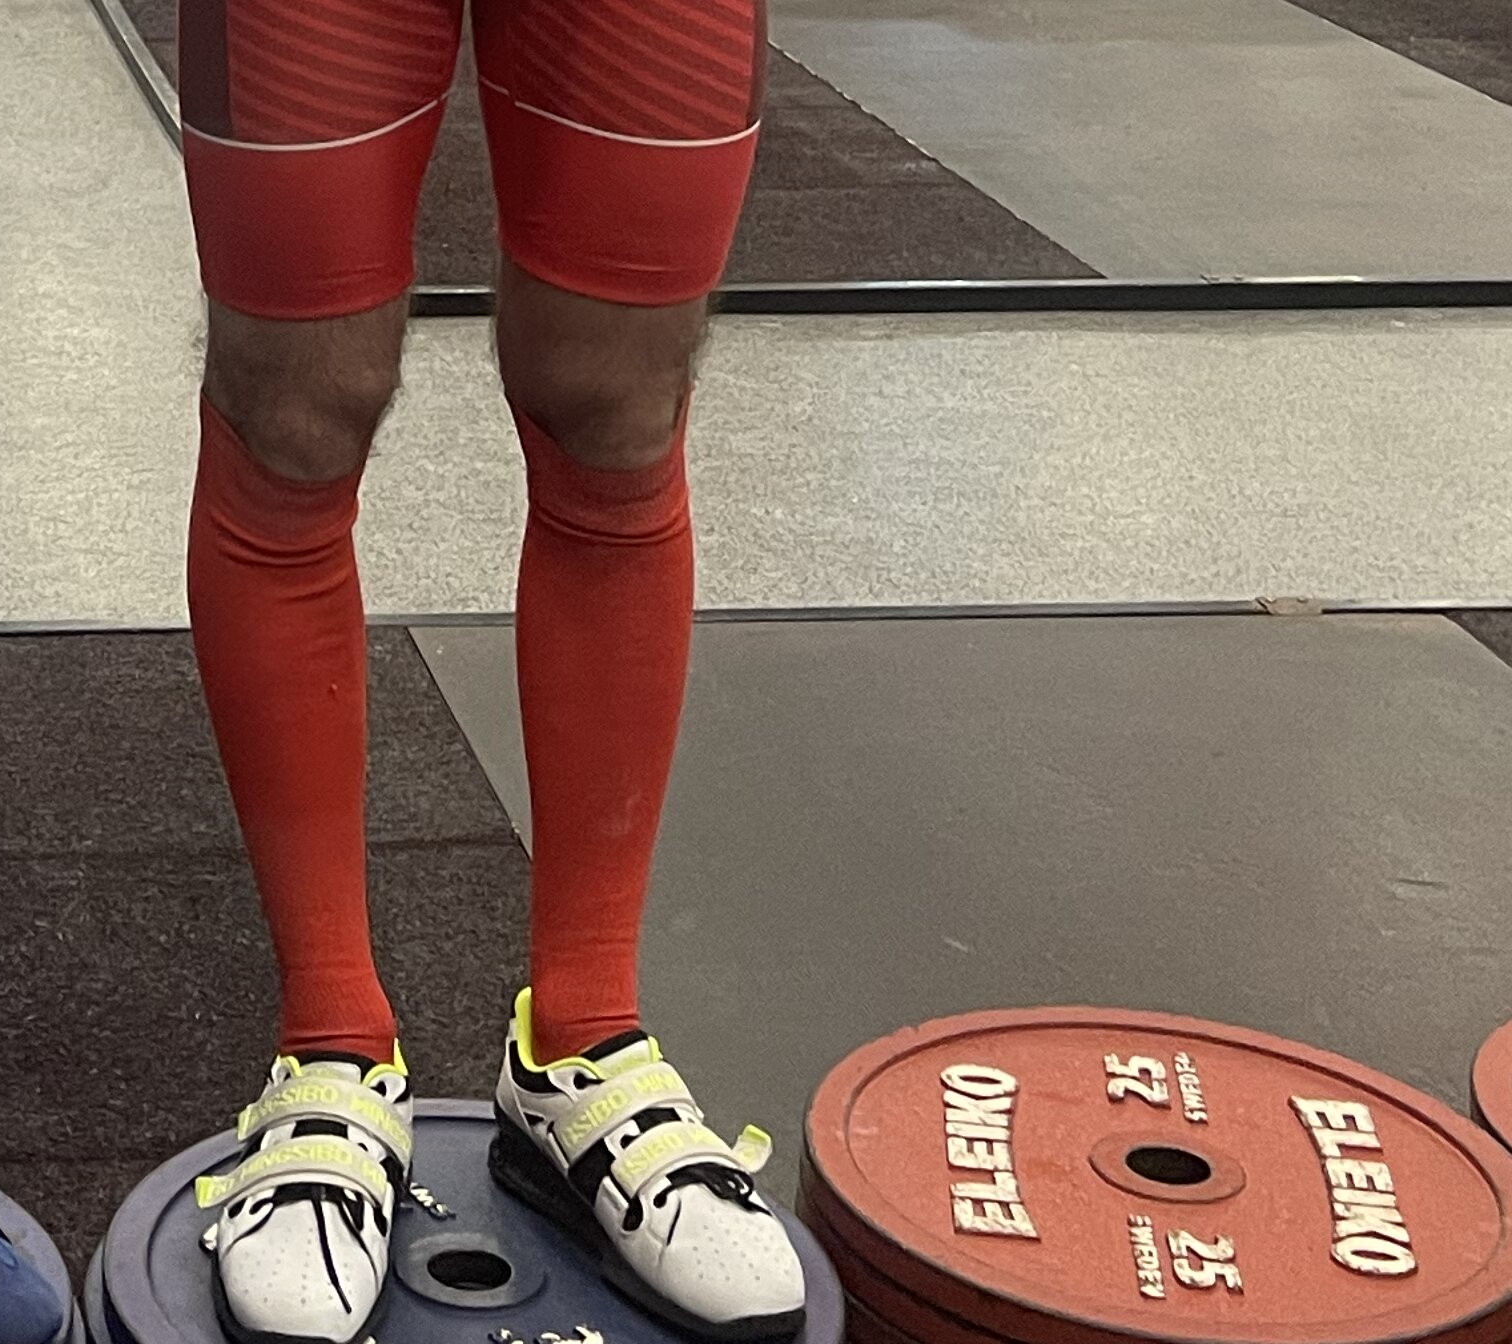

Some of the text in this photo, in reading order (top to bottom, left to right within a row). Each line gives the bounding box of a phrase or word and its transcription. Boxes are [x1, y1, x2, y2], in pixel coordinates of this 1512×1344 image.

[1104, 1052, 1172, 1110] 25
[940, 1063, 1040, 1242] ELEIKO
[1289, 1094, 1418, 1279] ELEIKO
[1167, 1227, 1244, 1293] 25
